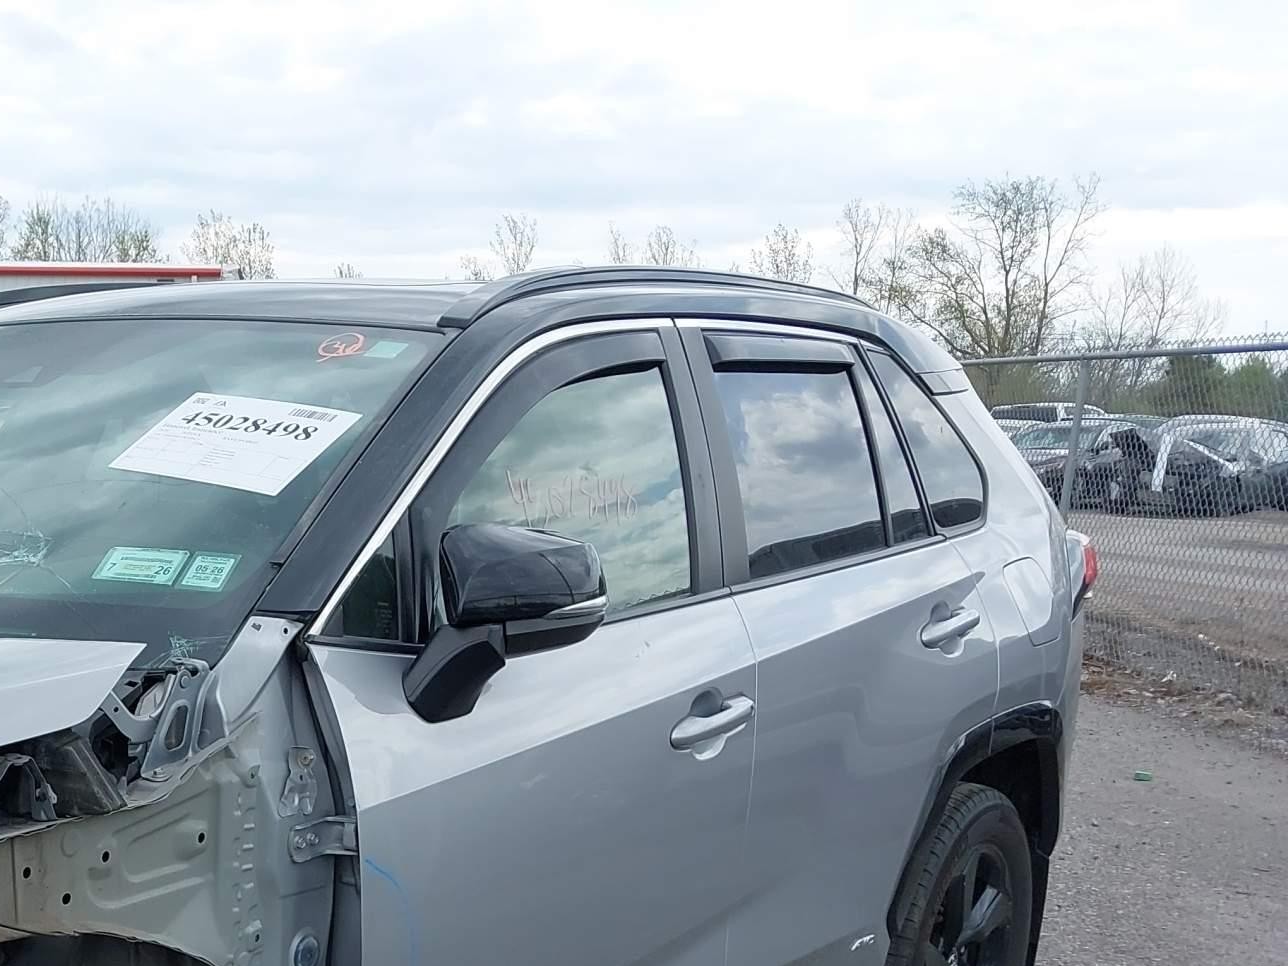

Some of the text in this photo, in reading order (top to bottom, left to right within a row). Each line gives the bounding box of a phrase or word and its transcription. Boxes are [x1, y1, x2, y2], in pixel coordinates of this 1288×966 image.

[181, 410, 320, 442] 45028498
[106, 562, 118, 572] 7
[153, 565, 173, 576] 26
[195, 564, 226, 575] 05 26
